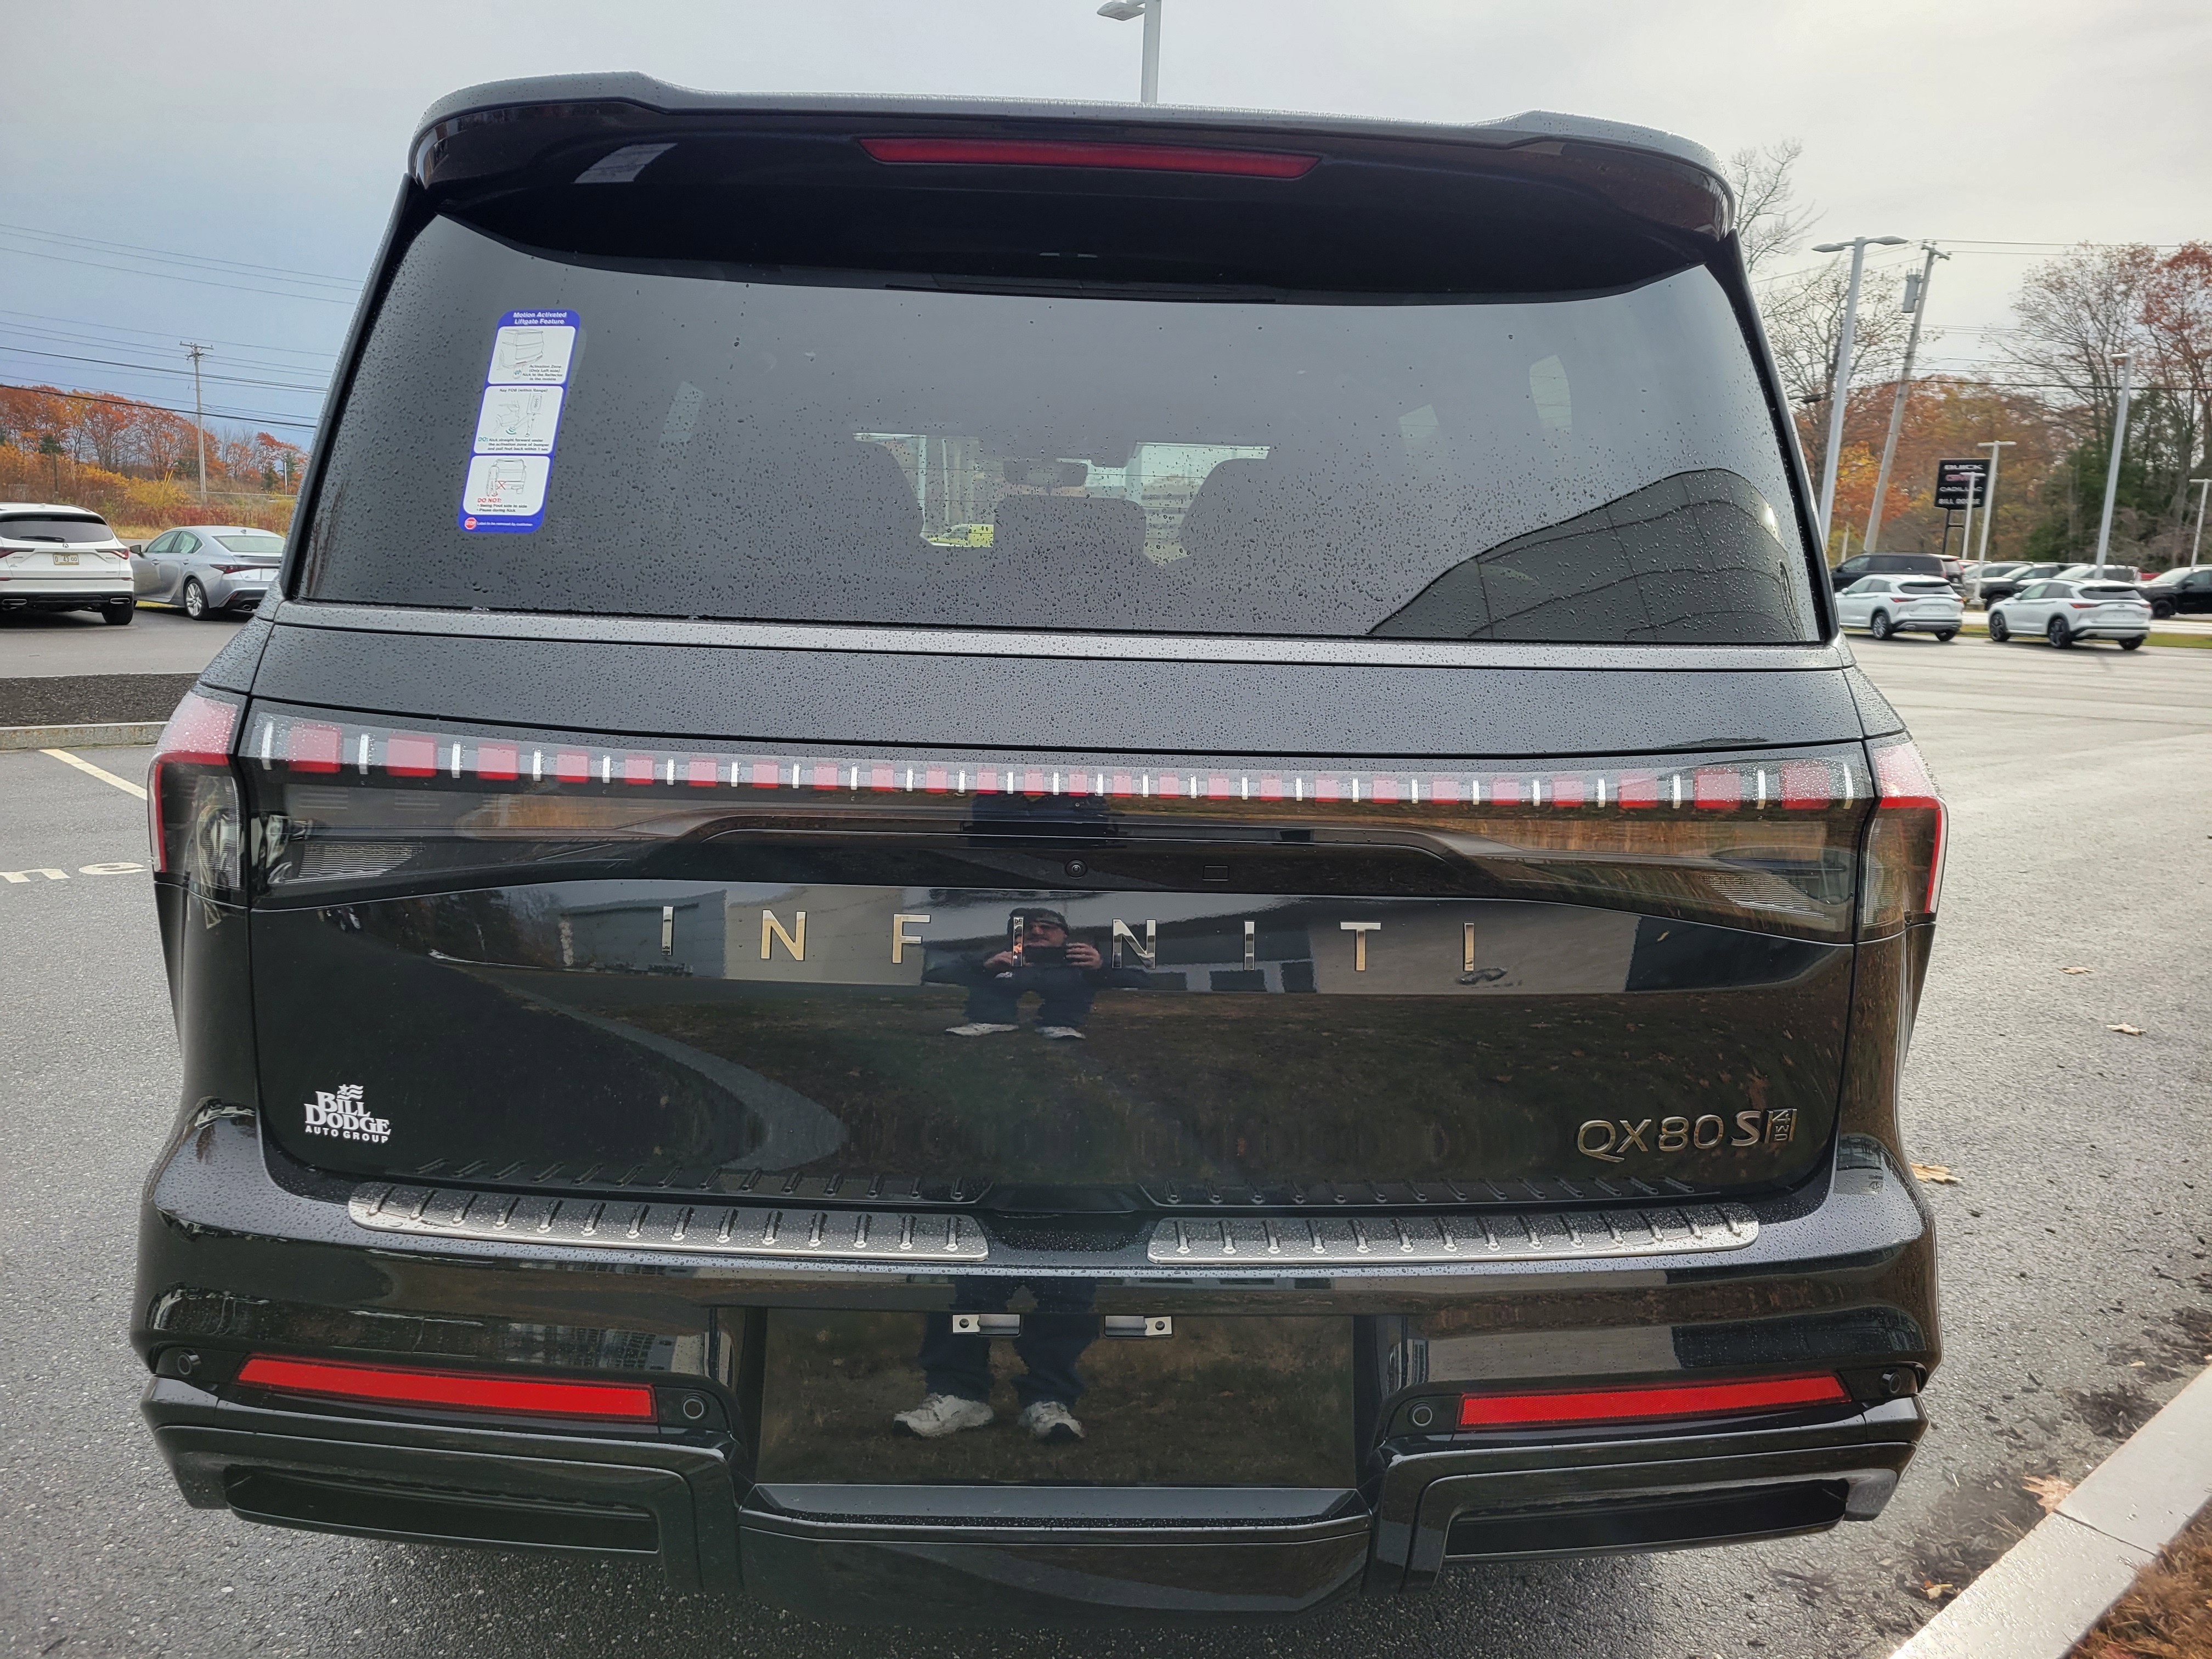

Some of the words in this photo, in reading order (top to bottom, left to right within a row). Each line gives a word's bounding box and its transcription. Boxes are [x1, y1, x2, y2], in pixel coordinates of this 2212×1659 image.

[661, 905, 1475, 972] INFINITI
[304, 1103, 392, 1135] DODGE
[315, 1091, 371, 1118] BILL
[305, 1125, 339, 1137] AUTO
[343, 1130, 389, 1143] GROUP
